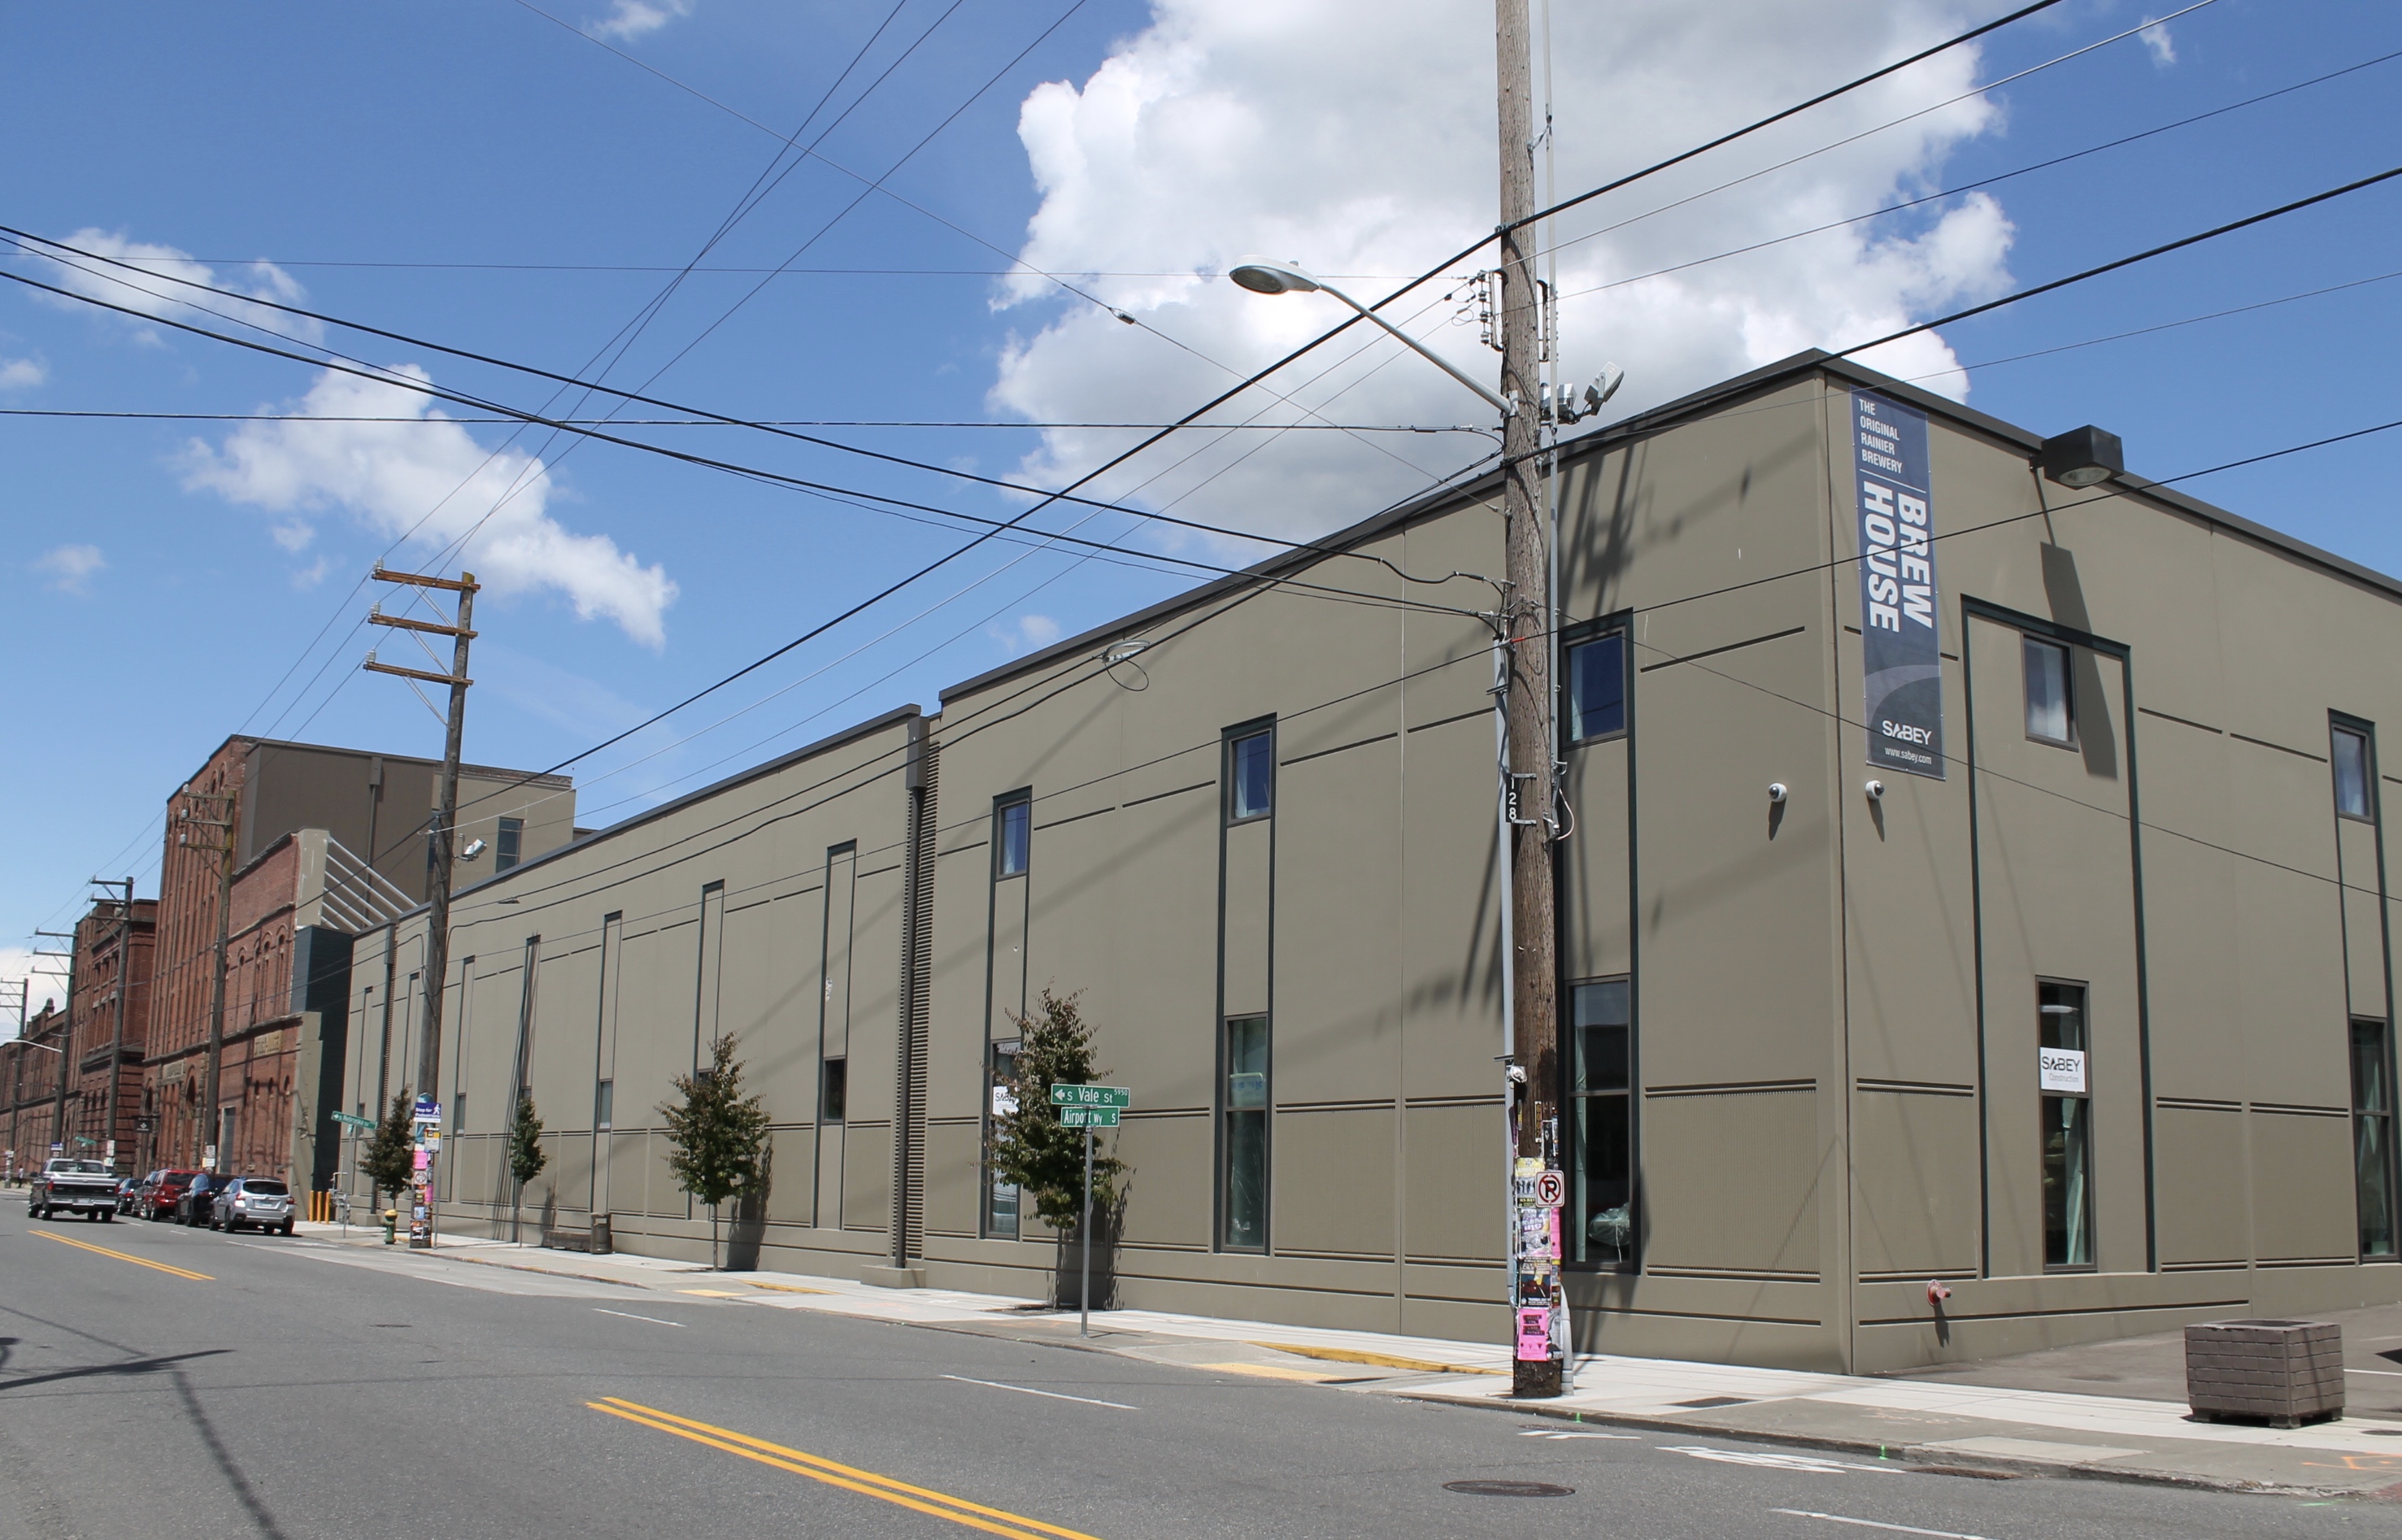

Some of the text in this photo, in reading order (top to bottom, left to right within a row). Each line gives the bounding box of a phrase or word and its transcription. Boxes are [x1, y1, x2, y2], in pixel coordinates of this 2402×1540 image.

[1859, 398, 1876, 415] THE
[1860, 415, 1899, 441] ORIGINAL
[1860, 432, 1895, 455] RAINIER
[1862, 449, 1902, 474] BREWERY
[1863, 481, 1899, 633] HOUSE
[1898, 493, 1933, 629] BREW
[1882, 720, 1932, 745] SABEY
[1884, 746, 1932, 765] www.sabey.com
[1508, 777, 1516, 820] 128
[2042, 1056, 2081, 1072] SABEY
[2049, 1073, 2079, 1082] Construction
[994, 1092, 1016, 1103] SAB
[1067, 1090, 1073, 1101] S
[1078, 1087, 1099, 1103] Vale
[1103, 1093, 1113, 1103] St
[1094, 1113, 1103, 1126] Wy
[1112, 1112, 1116, 1123] S
